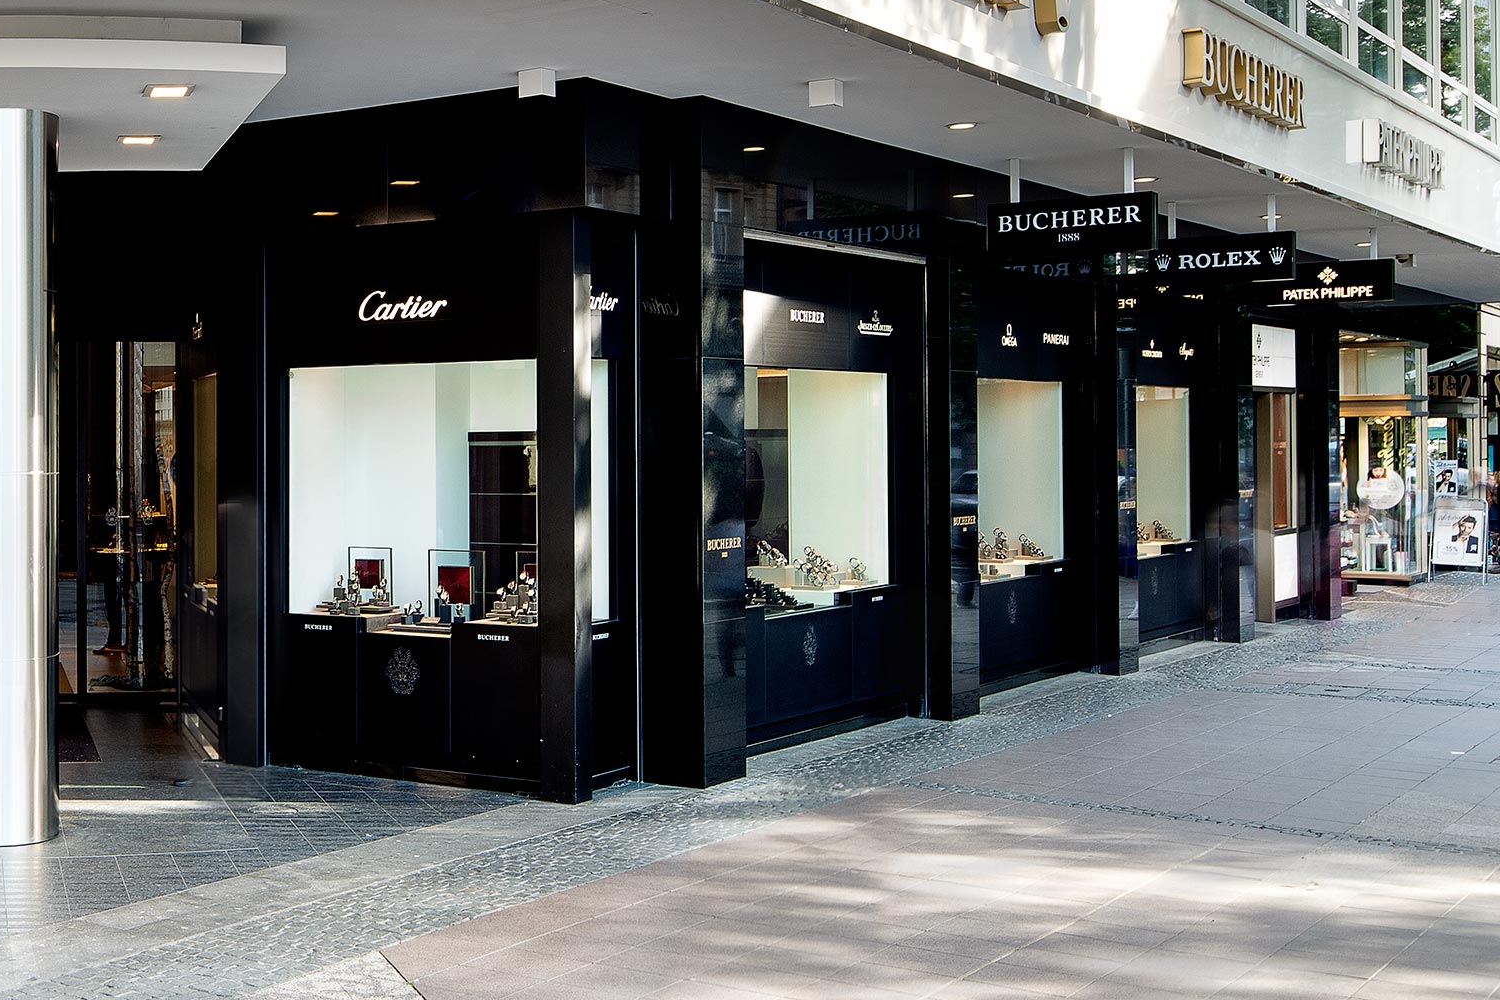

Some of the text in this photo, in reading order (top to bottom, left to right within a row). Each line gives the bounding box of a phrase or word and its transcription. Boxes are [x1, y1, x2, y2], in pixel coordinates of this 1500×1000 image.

[1182, 27, 1306, 130] BUCHERER
[998, 205, 1142, 234] BUCHERER
[1057, 232, 1081, 243] 1888
[1179, 249, 1262, 270] ROLEX
[589, 286, 619, 312] artier
[1283, 284, 1374, 301] PATEK PHILIPPE
[358, 291, 448, 321] Cartier
[790, 308, 825, 324] BUCHERER
[706, 536, 742, 551] BUCHERER
[477, 633, 510, 642] BUCHERER
